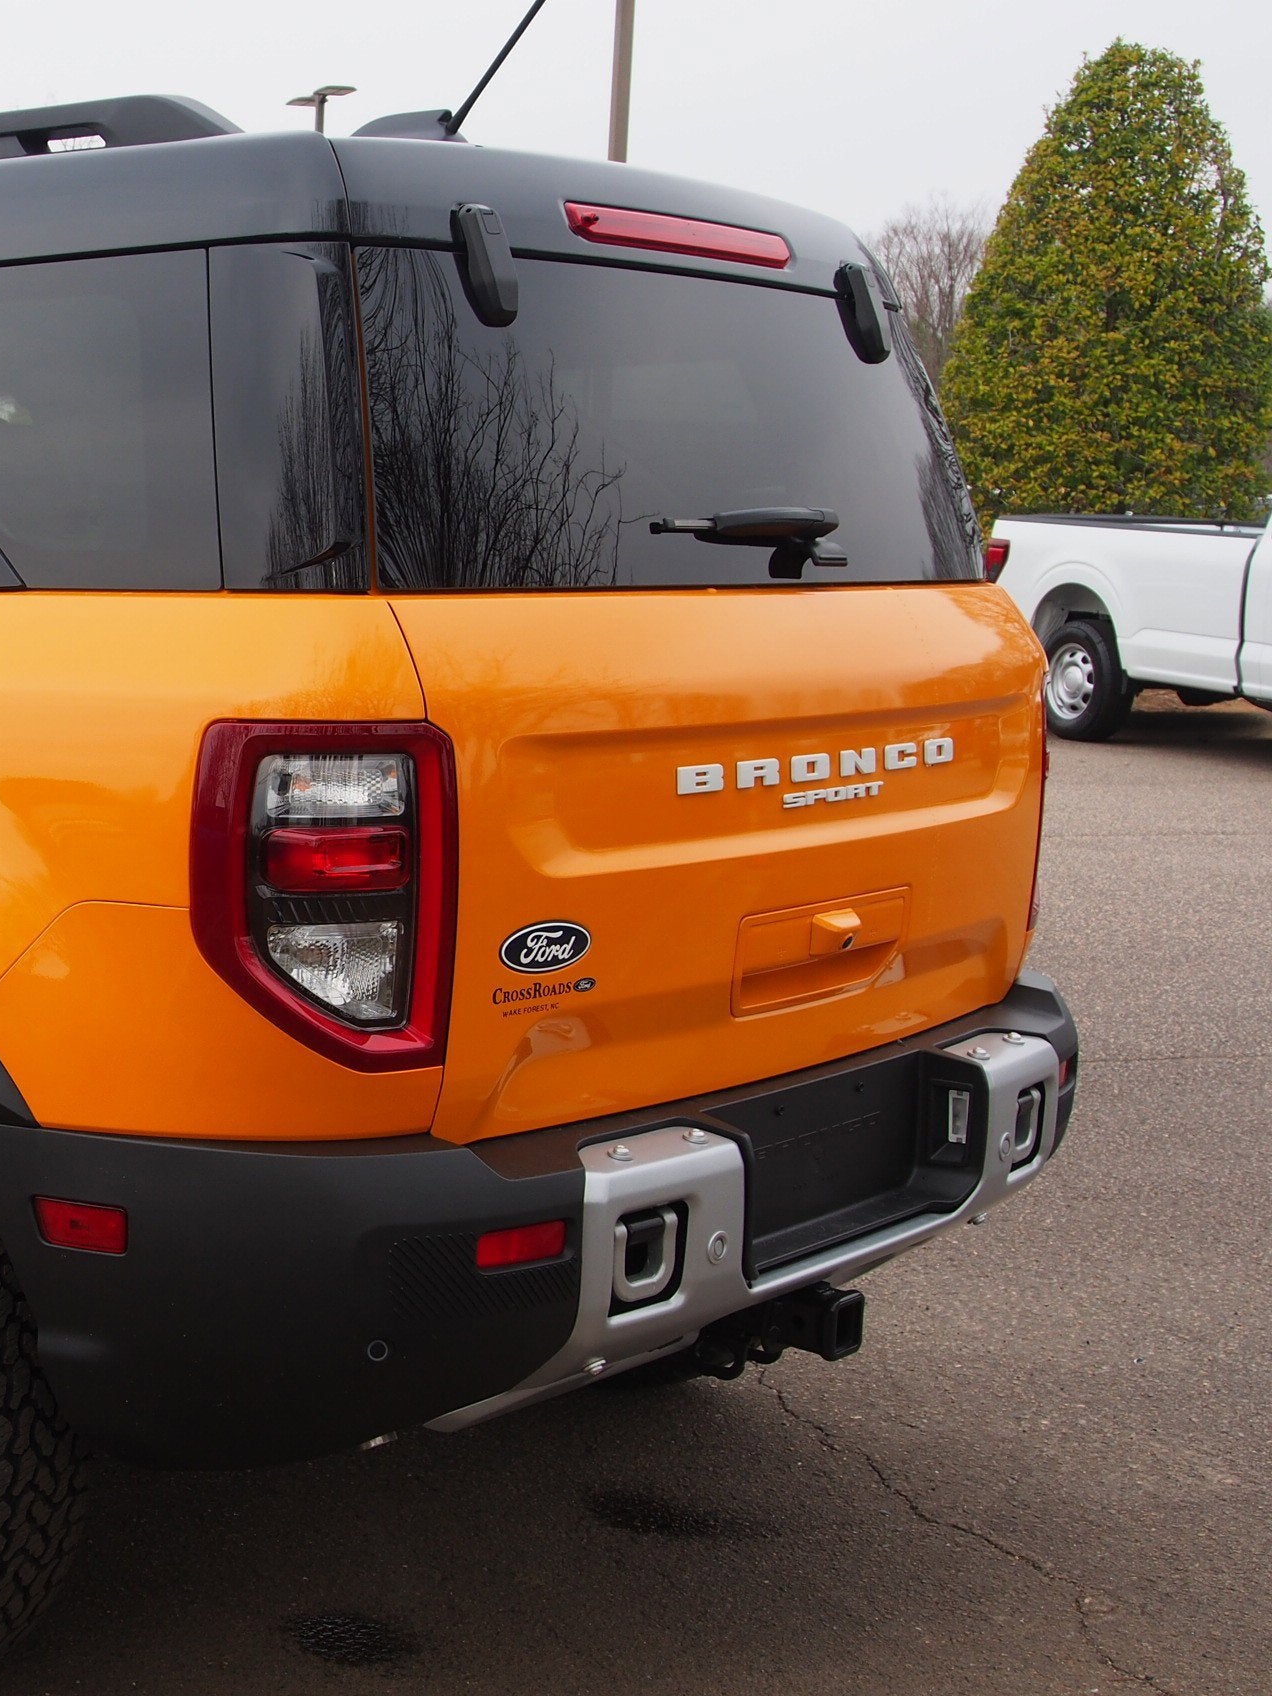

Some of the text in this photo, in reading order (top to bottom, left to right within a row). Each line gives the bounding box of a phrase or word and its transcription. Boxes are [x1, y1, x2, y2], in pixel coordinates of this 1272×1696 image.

[676, 737, 954, 796] BRONCO
[782, 780, 885, 809] SPORT
[519, 930, 577, 965] Ford
[502, 1002, 560, 1018] WAKE FOREST, NC
